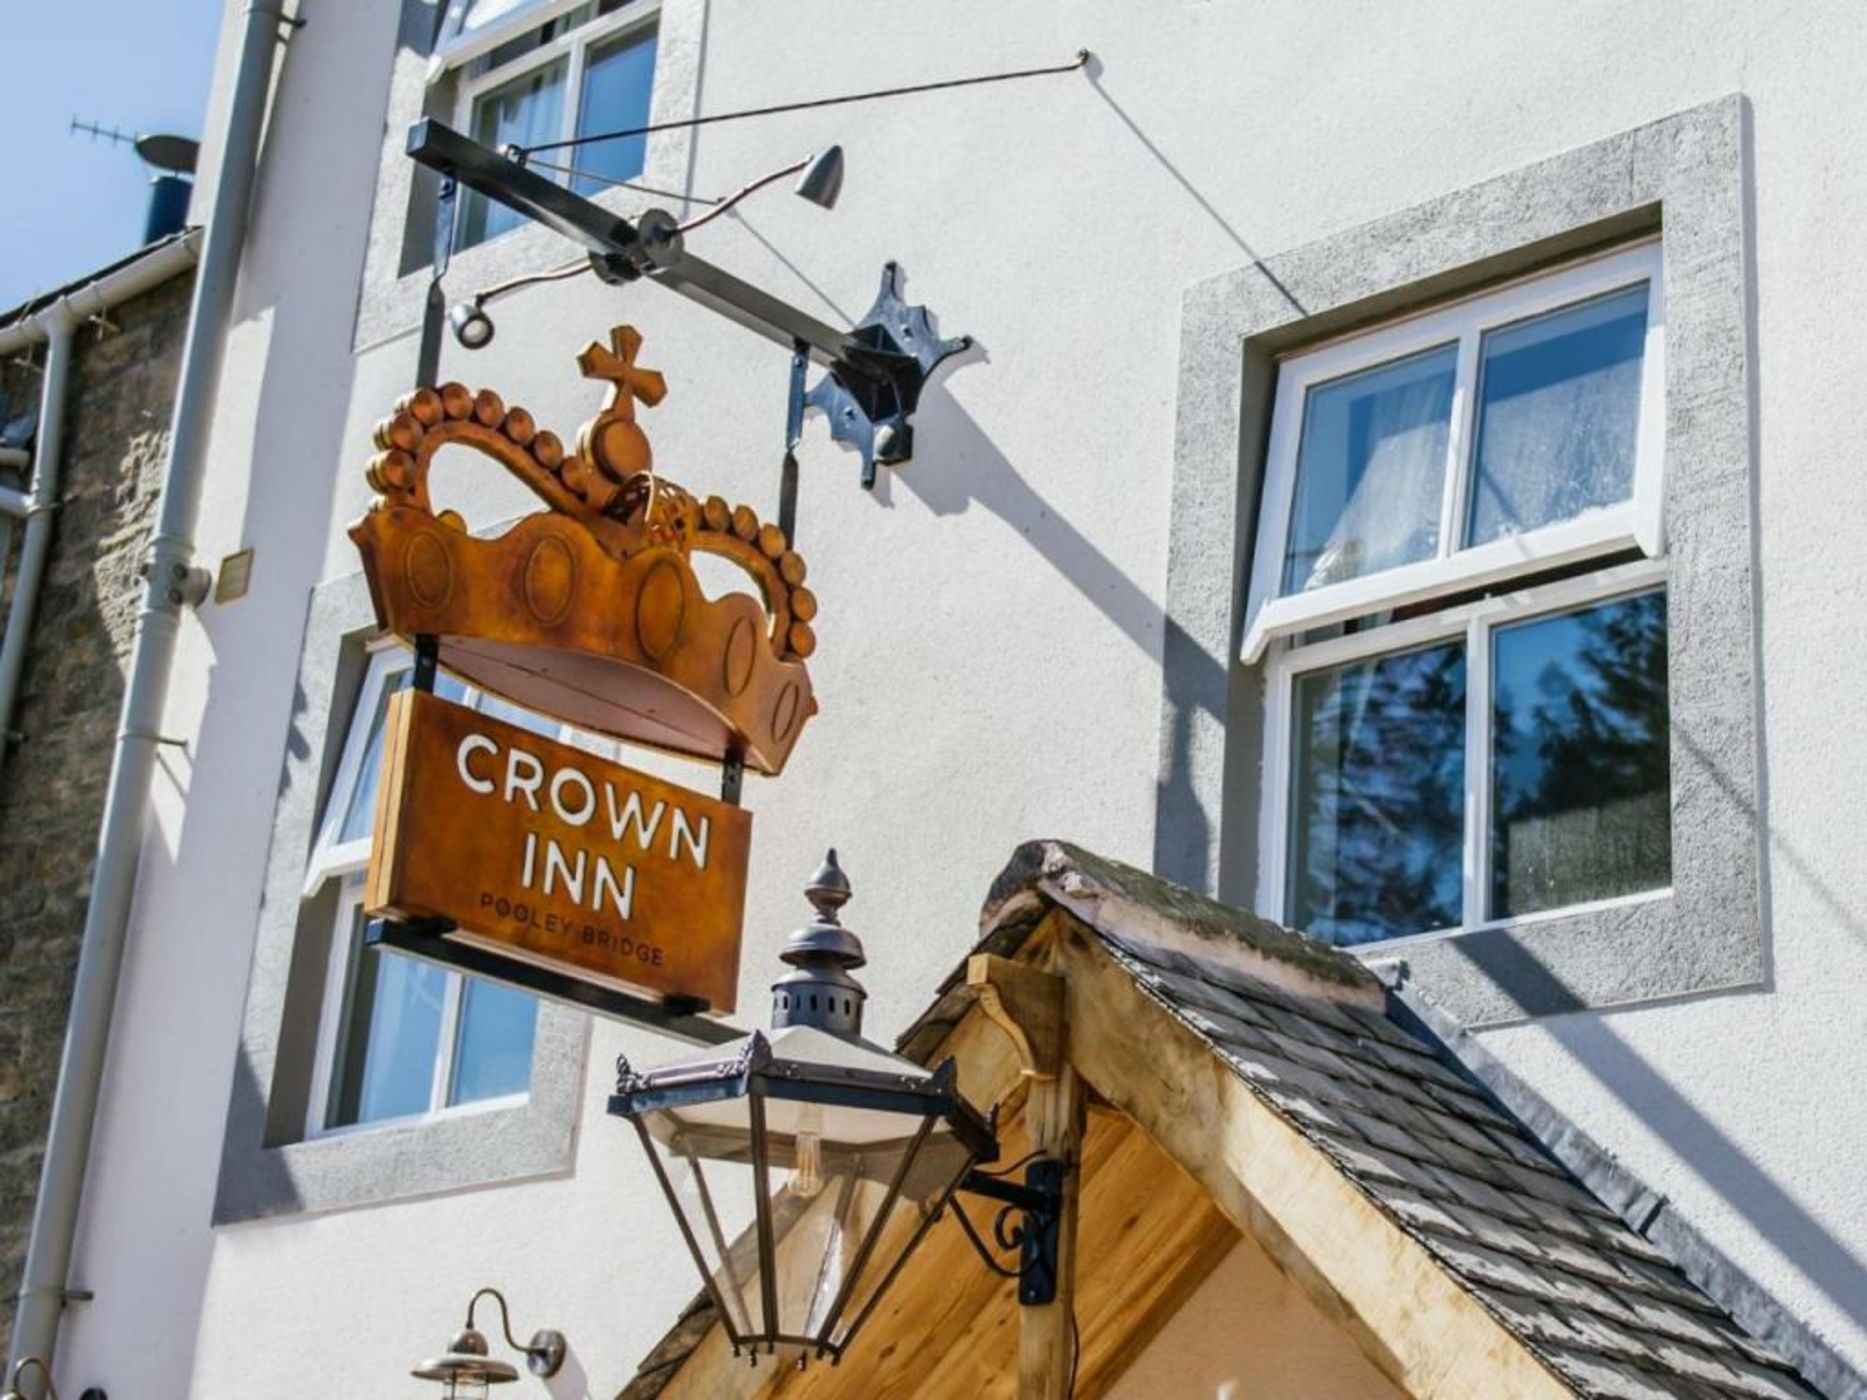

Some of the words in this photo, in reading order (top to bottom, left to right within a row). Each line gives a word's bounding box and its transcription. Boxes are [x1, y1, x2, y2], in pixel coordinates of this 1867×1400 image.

[457, 734, 710, 869] CROWN
[523, 833, 634, 920] INN
[481, 892, 572, 935] POOLEY
[583, 925, 664, 966] BRIDGE
